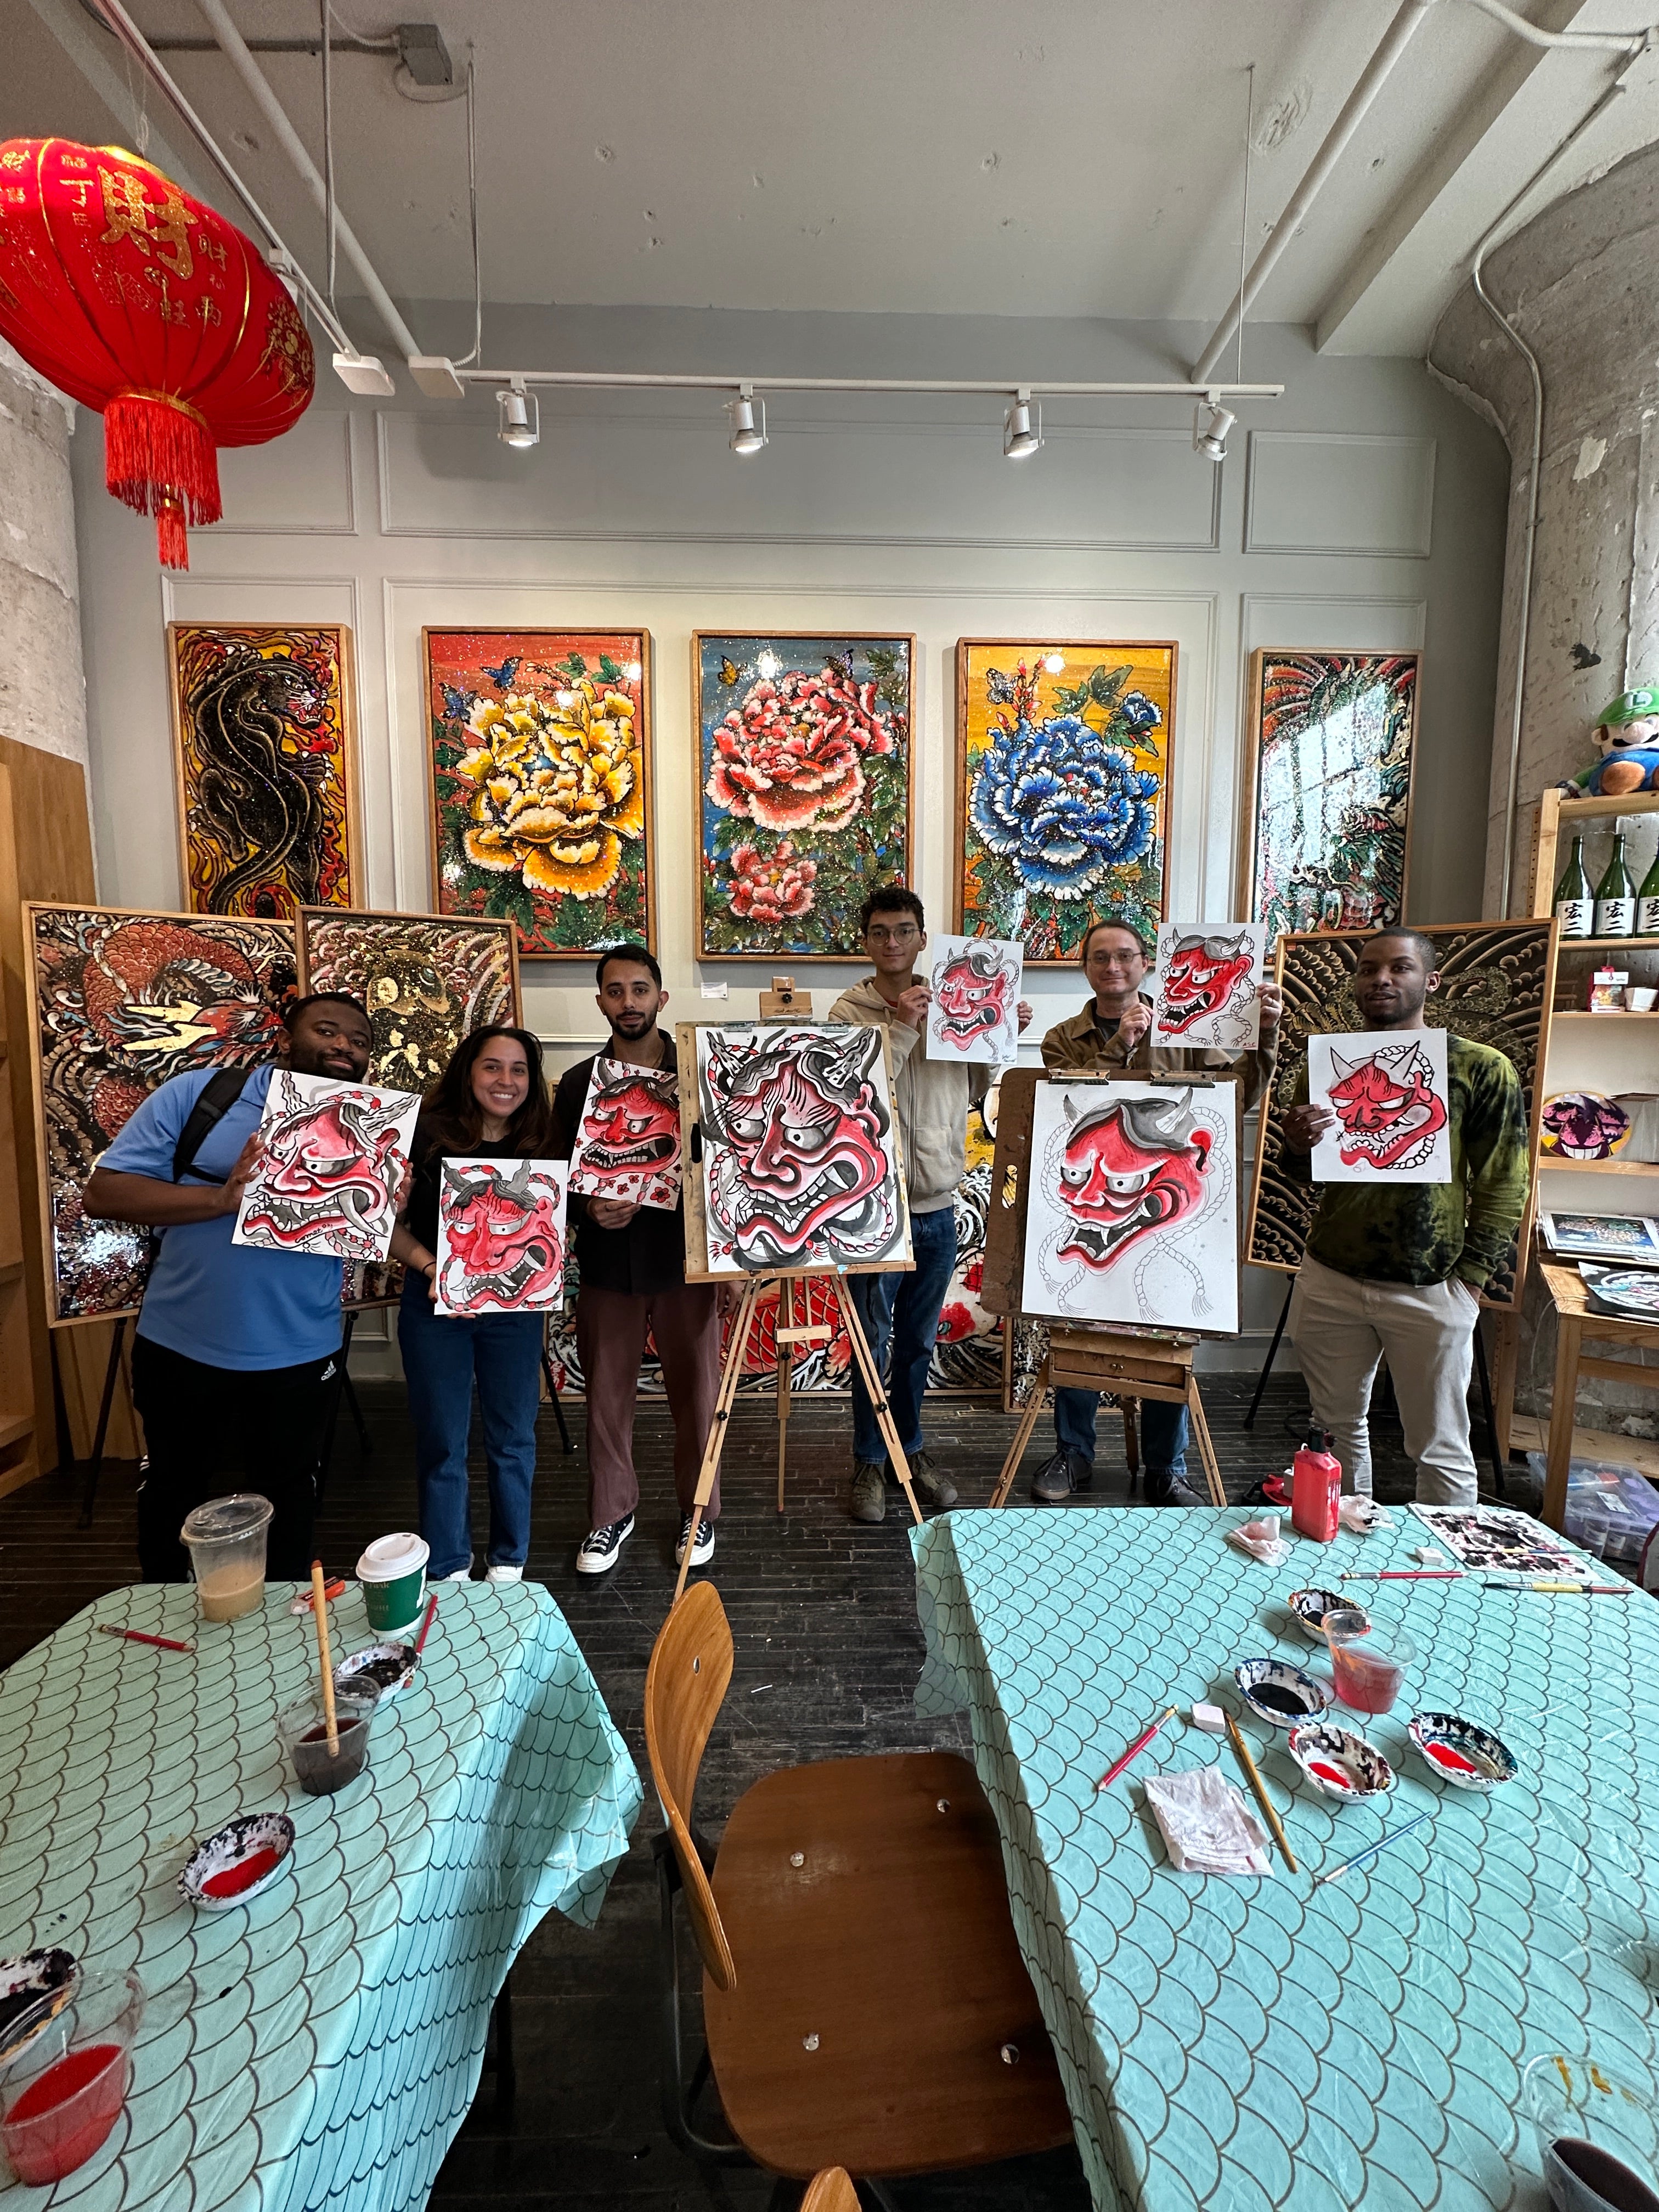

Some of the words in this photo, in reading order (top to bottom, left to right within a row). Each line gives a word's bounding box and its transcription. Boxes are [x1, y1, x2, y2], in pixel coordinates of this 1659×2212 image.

[1633, 694, 1646, 706] L
[1564, 902, 1584, 932] 宏二
[1605, 901, 1626, 931] 宏二
